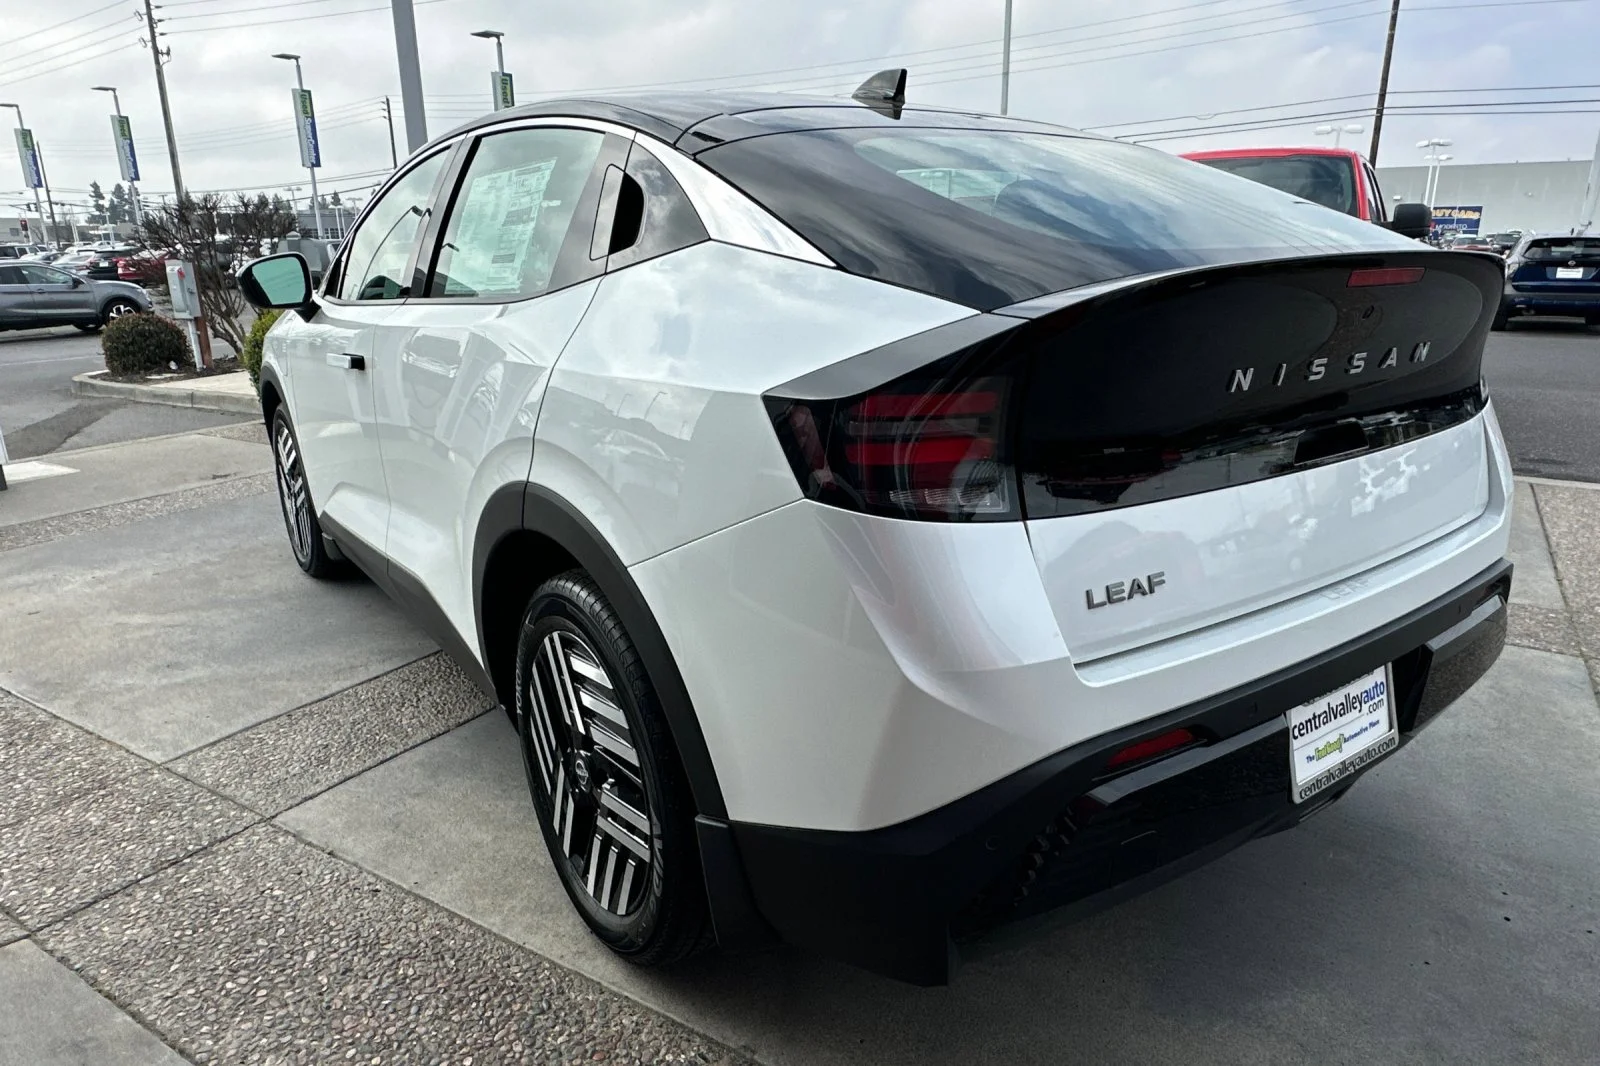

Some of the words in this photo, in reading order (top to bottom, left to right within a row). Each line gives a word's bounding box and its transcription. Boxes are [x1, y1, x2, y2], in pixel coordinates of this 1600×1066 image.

[300, 93, 310, 116] Used
[501, 77, 510, 105] Used
[1229, 341, 1431, 393] NISSAN
[1085, 571, 1166, 610] LEAF
[1366, 698, 1385, 716] .com
[1299, 736, 1396, 800] centralvalleyauto.com
